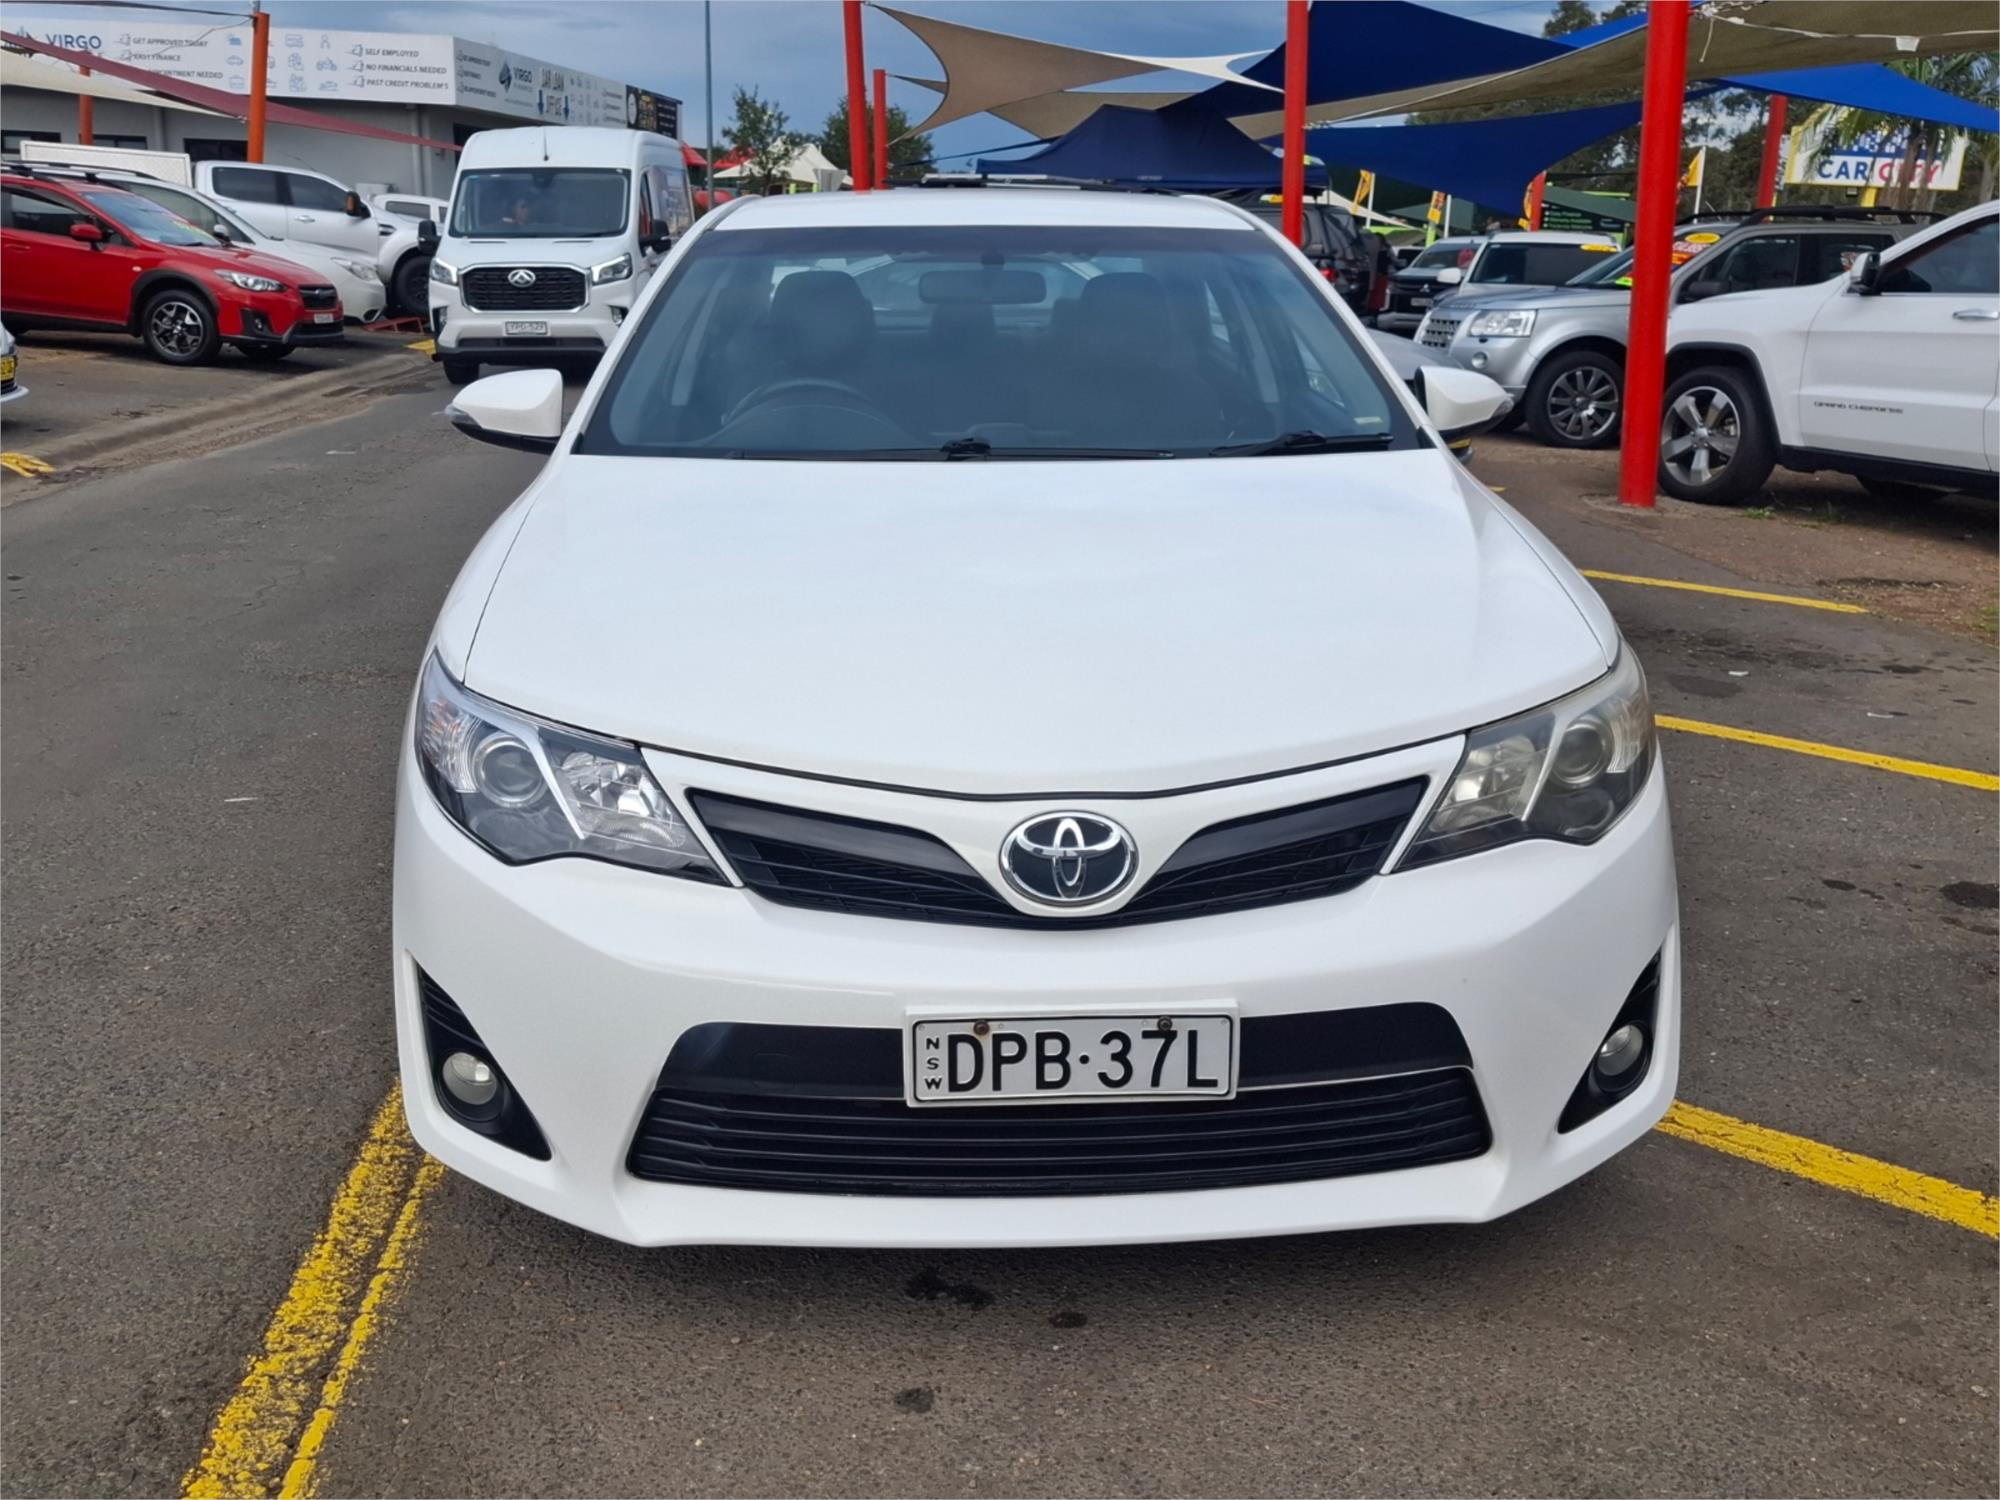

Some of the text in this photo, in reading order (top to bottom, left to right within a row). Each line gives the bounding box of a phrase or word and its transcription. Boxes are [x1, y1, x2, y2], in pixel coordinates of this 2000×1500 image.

[46, 33, 102, 50] VIRGO
[132, 37, 146, 45] GET
[147, 38, 184, 47] APPROVED
[151, 53, 181, 62] FINANCE
[365, 48, 420, 58] SELF EMPLOYED
[196, 70, 224, 79] NEEDED
[366, 63, 448, 75] NO FINANCIALS NEEDED
[366, 79, 449, 90] PAST CREDIT PROBLEMS
[1818, 160, 1869, 180] CAR
[924, 1036, 943, 1090] NSW
